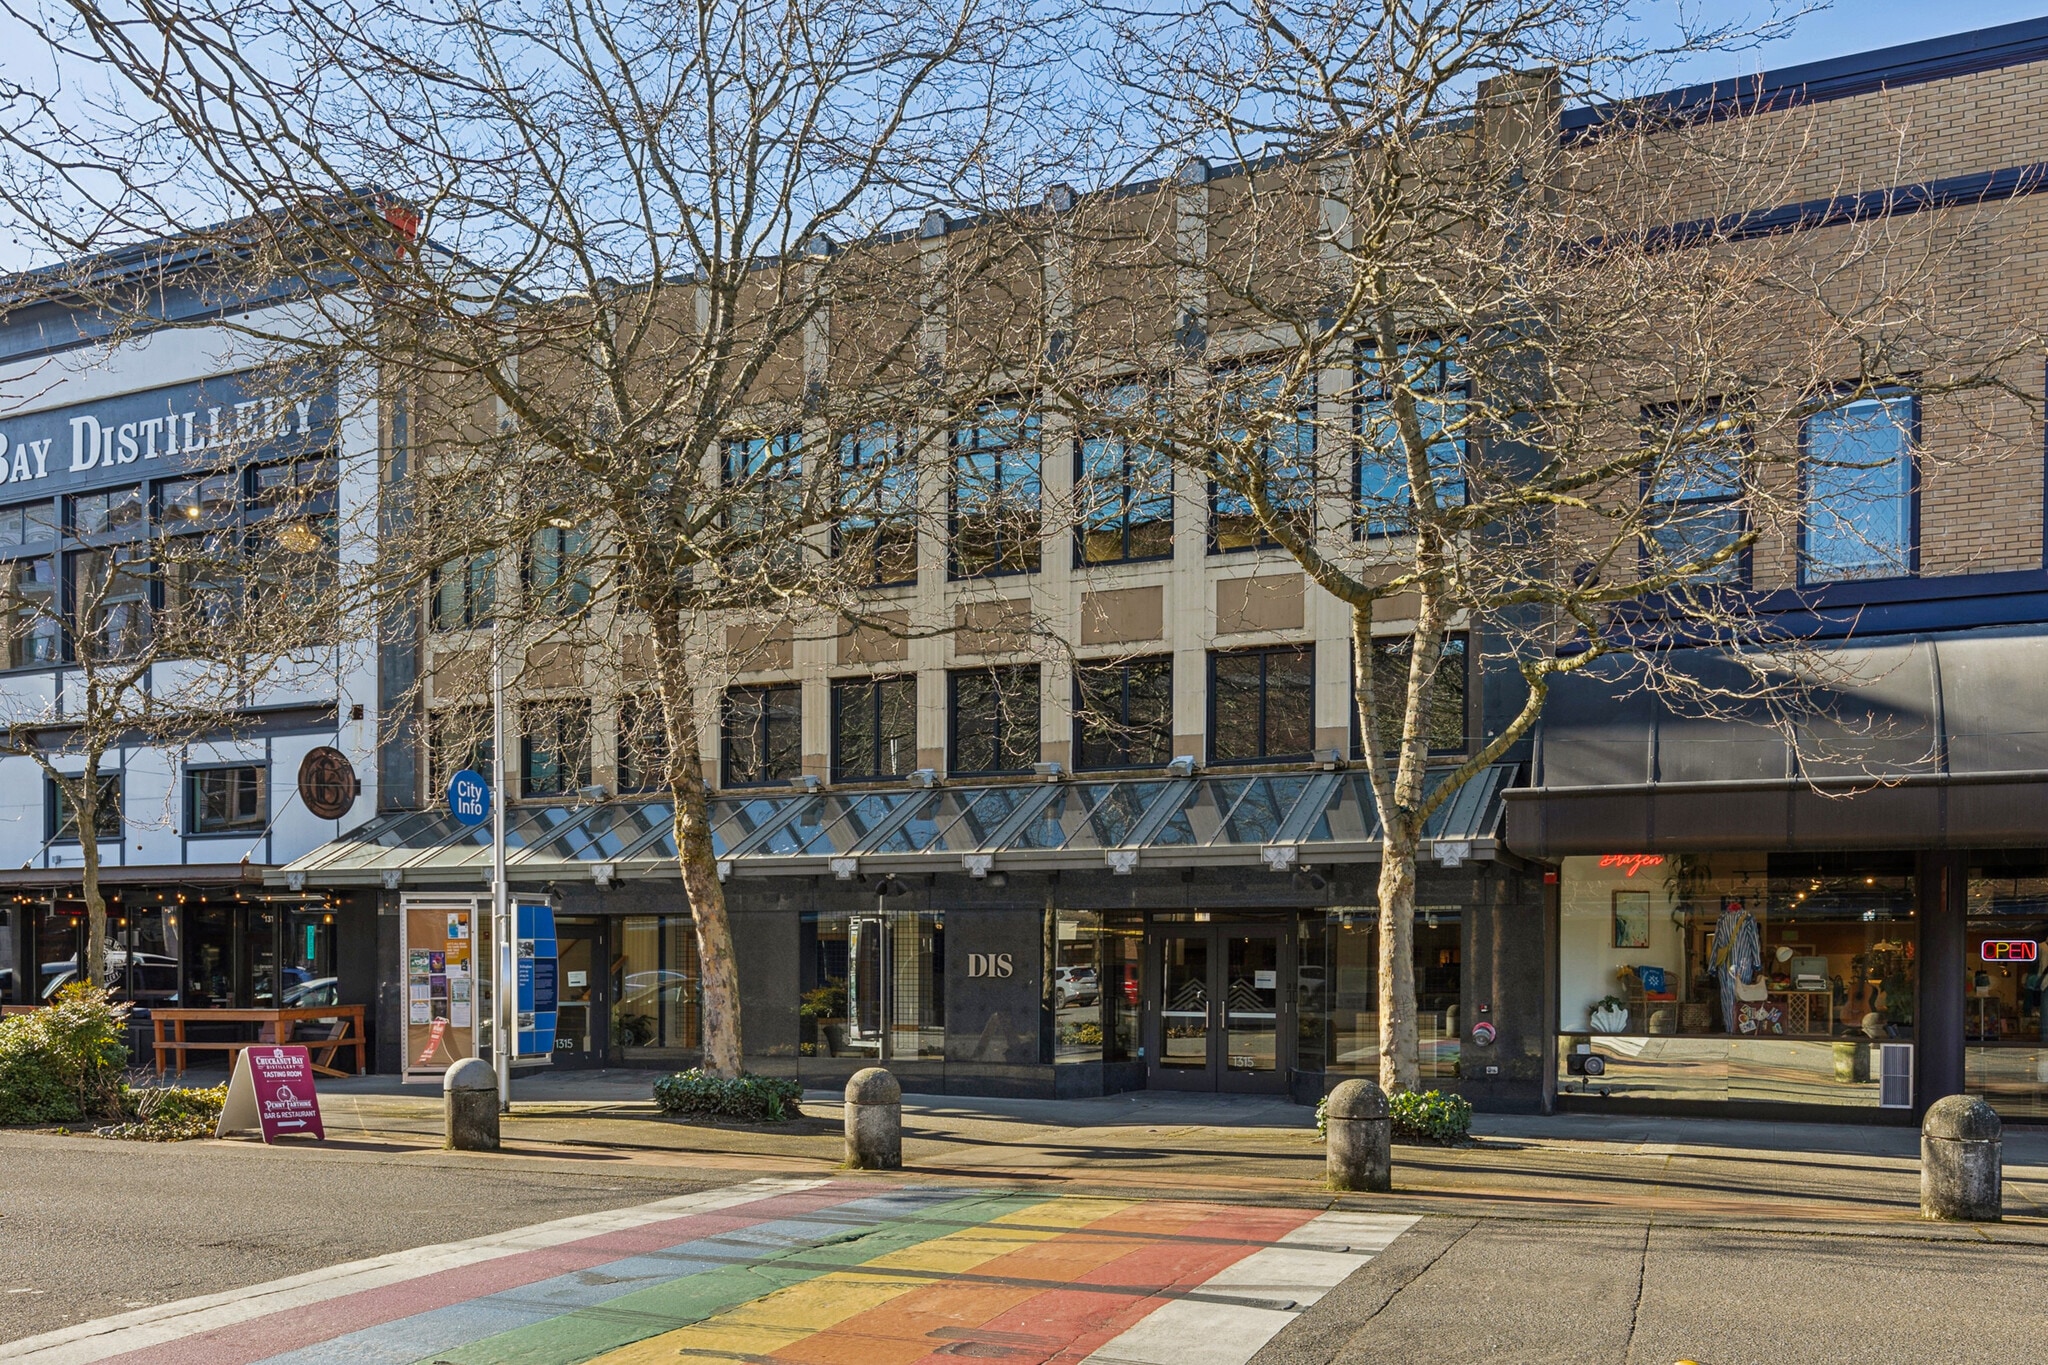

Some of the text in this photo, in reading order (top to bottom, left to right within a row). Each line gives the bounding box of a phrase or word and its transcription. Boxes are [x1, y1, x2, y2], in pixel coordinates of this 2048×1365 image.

[457, 780, 482, 802] City
[458, 797, 482, 816] Info
[1984, 942, 2035, 959] OPEN
[967, 953, 1013, 978] DIS
[555, 1038, 573, 1049] 1315
[1232, 1056, 1255, 1068] 1315
[281, 1110, 316, 1118] RESTAURANT
